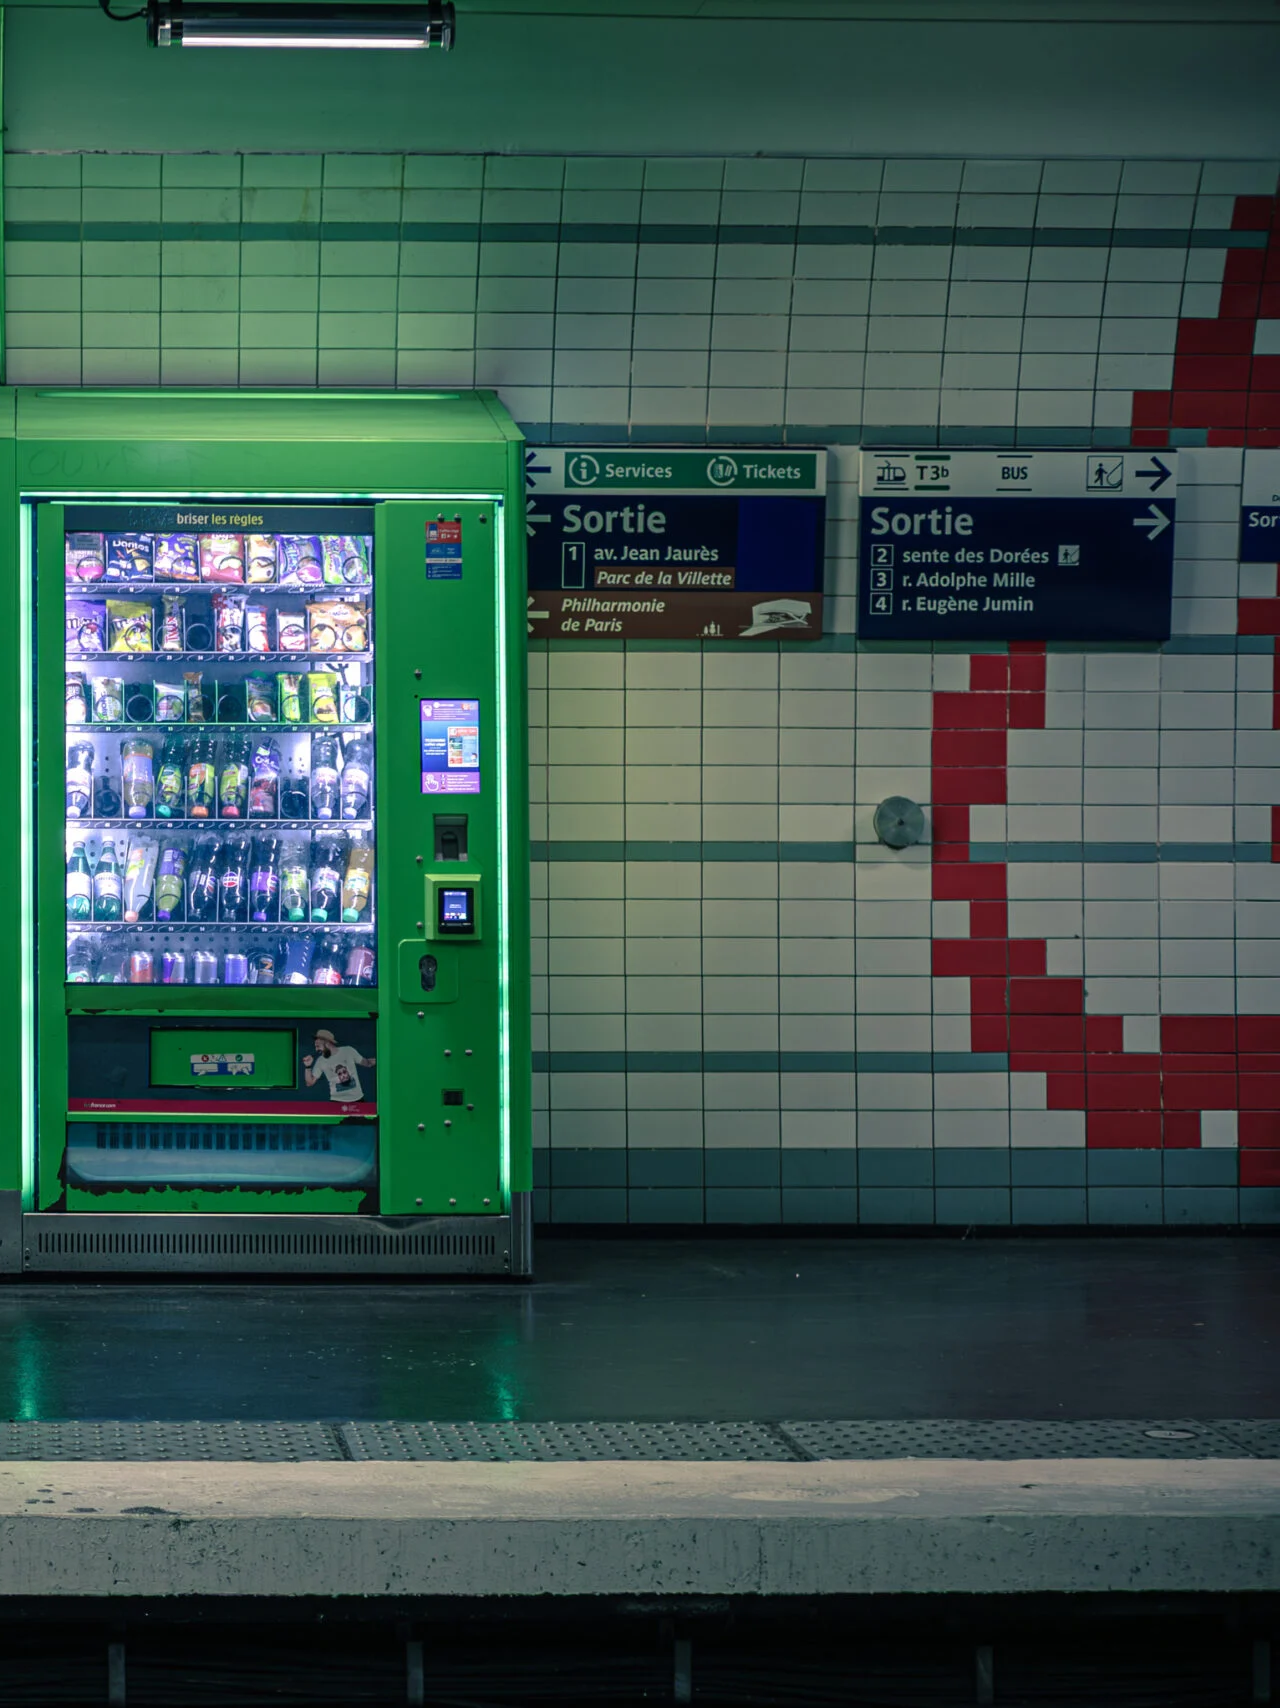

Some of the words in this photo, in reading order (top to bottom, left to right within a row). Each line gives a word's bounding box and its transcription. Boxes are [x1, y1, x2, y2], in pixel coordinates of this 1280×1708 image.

[605, 464, 673, 479] Services
[743, 464, 801, 480] Tickets
[1001, 466, 1029, 480] BUS
[176, 513, 210, 525] briser
[211, 513, 227, 525] les
[229, 513, 264, 527] règles
[562, 504, 666, 534] Sortie
[870, 506, 974, 536] Sortie
[1248, 511, 1280, 528] Sor
[112, 540, 150, 552] Doritos
[568, 546, 578, 561] 1
[594, 549, 618, 561] av.
[620, 546, 661, 563] Jean
[665, 545, 719, 562] Jaurès
[876, 548, 887, 563] 2
[902, 549, 950, 563] sente
[954, 547, 985, 563] des
[989, 546, 1050, 563] Dorées
[597, 571, 631, 586] Parc
[634, 571, 653, 586] de
[656, 571, 673, 586] la
[678, 571, 732, 586] Villette
[876, 572, 887, 588] 3
[902, 574, 912, 588] r.
[916, 571, 987, 591] Adolphe
[992, 572, 1036, 588] Mille
[561, 597, 665, 614] Philharmonie
[875, 597, 887, 612] 4
[901, 598, 912, 612] r.
[916, 595, 978, 615] Eugène
[982, 596, 1034, 612] Jumin
[561, 617, 580, 633] de
[585, 617, 623, 633] Paris
